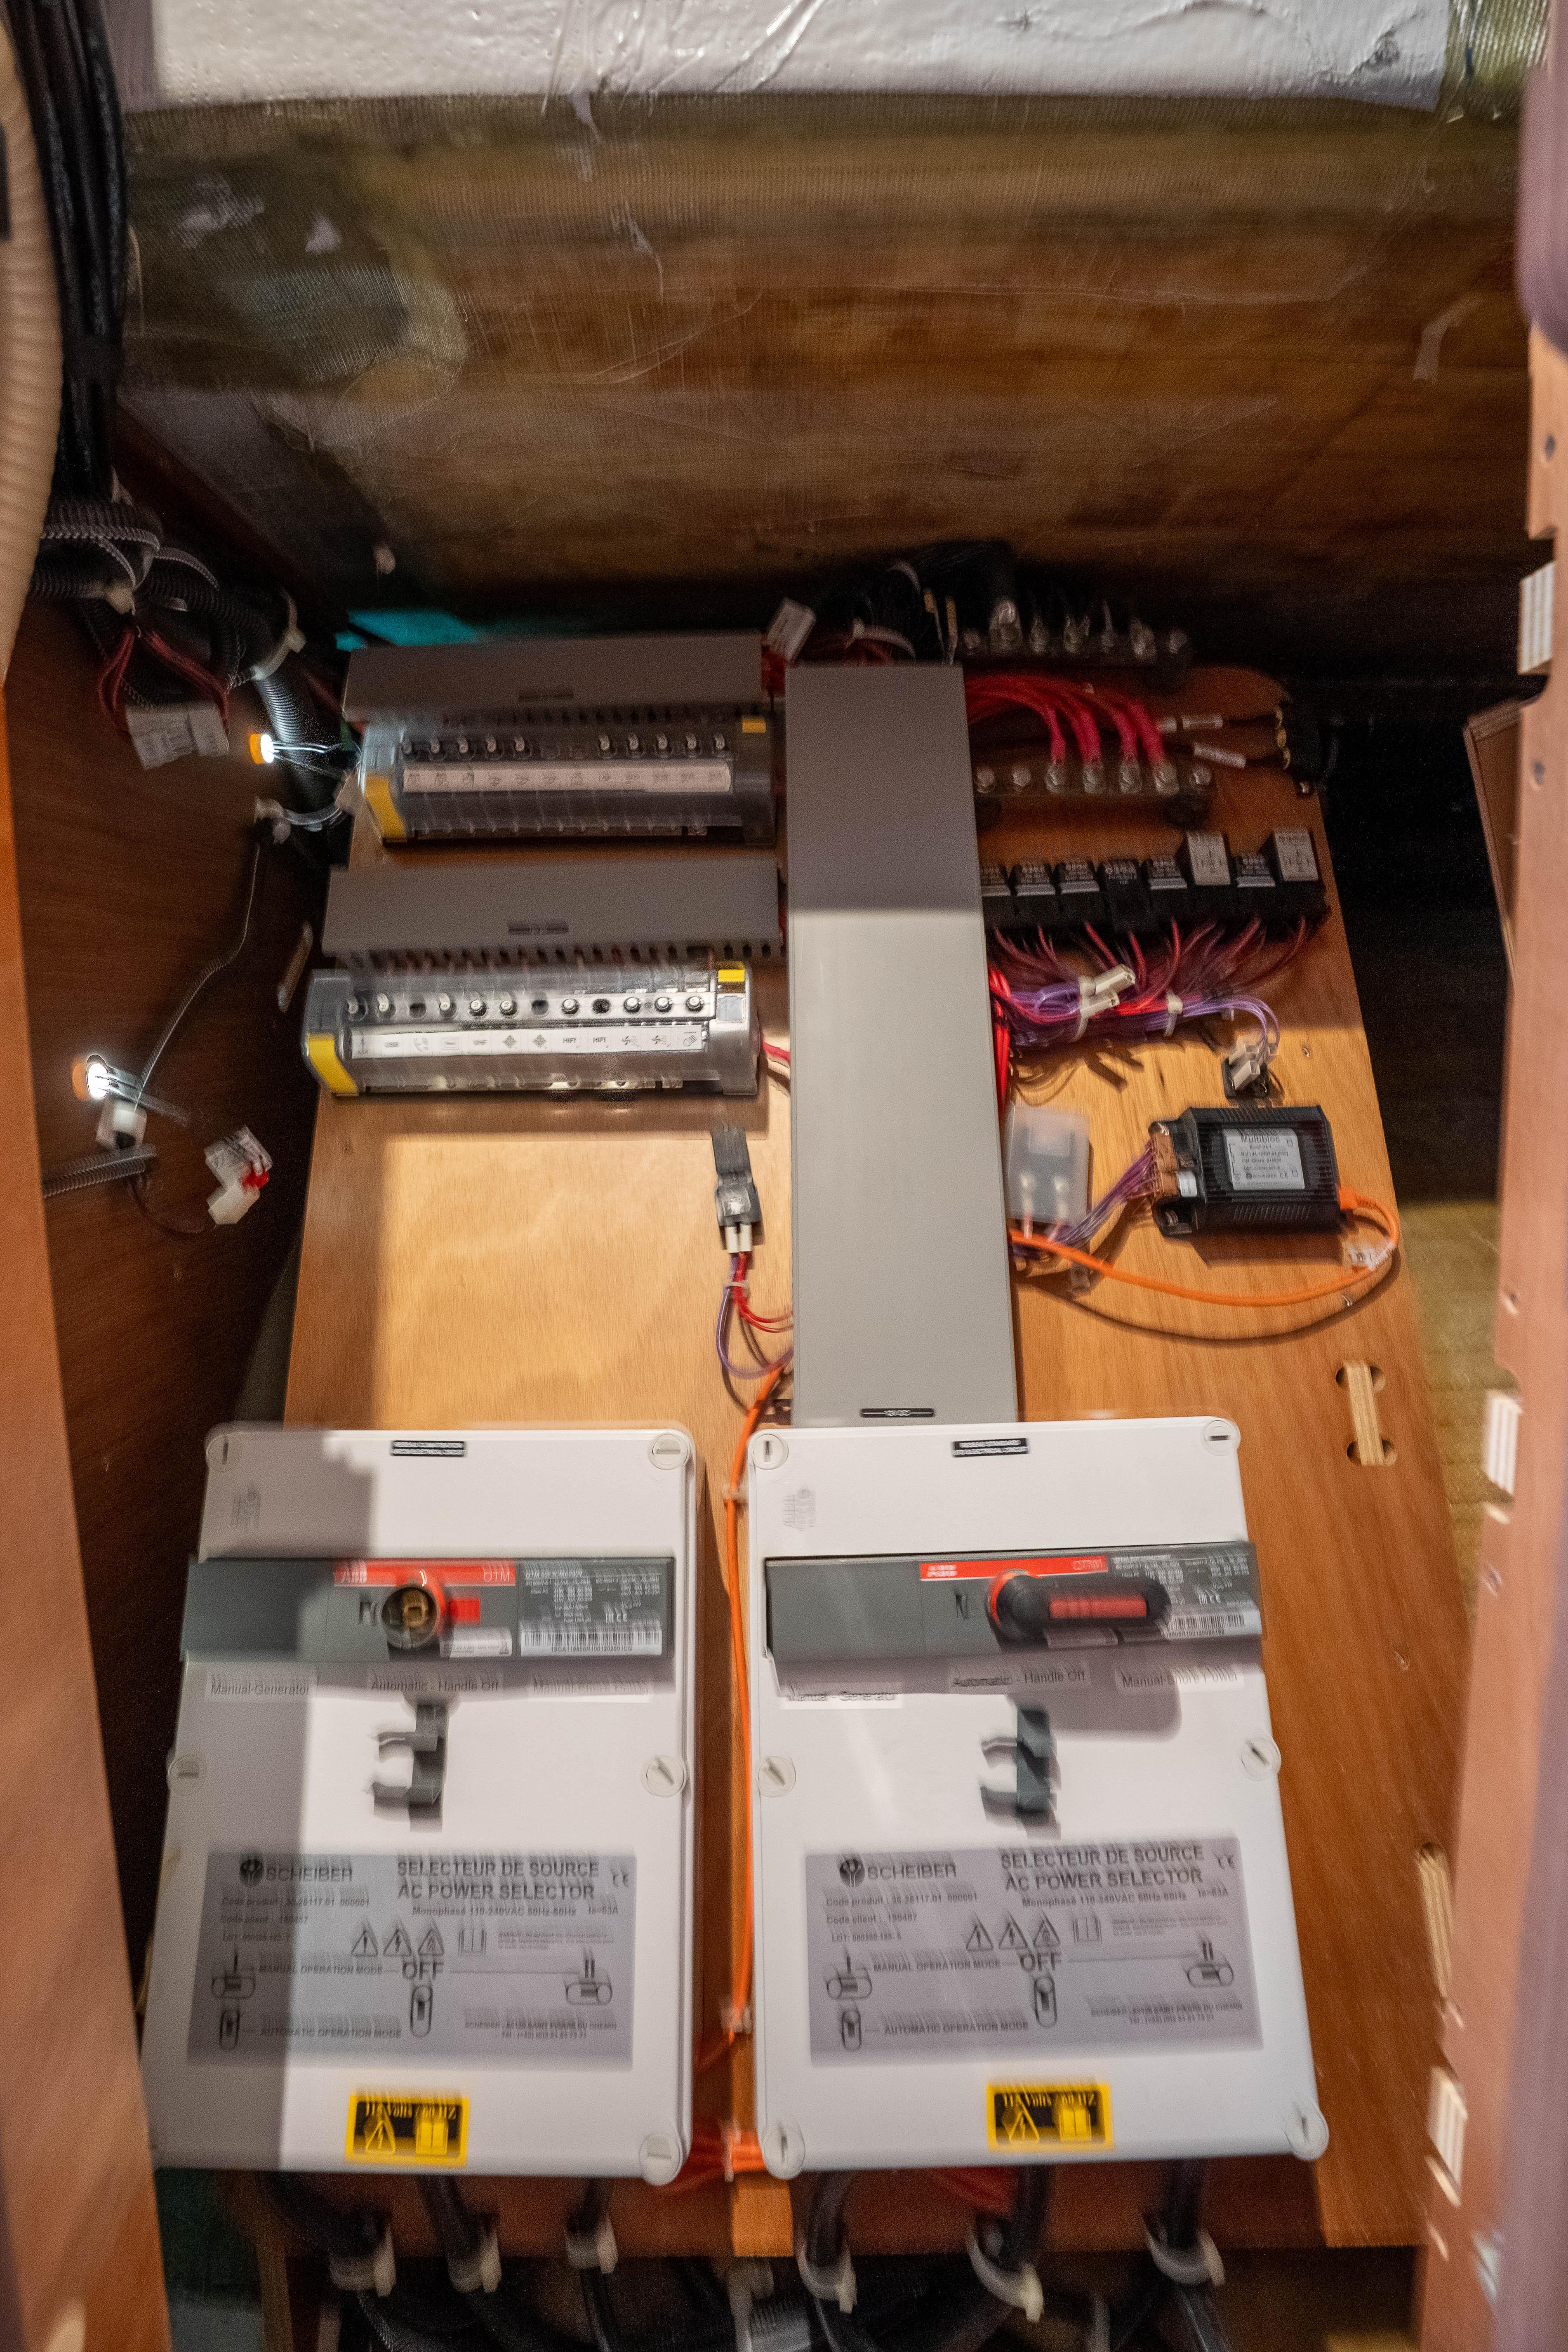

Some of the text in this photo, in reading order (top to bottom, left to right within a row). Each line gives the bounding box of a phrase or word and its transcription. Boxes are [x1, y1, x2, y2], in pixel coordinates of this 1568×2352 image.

[483, 1571, 510, 1582] OTM
[1025, 1673, 1064, 1684] Handle
[438, 1681, 478, 1692] Handle
[1001, 1846, 1204, 1870] SELECTEUR DE SOURCE
[266, 1867, 353, 1882] SCHEIBER
[398, 1862, 600, 1877] SELECTEUR DE SOURCE
[867, 1865, 957, 1881] SCHEIBER
[1005, 1868, 1203, 1892] AC POWER SELECTOR
[398, 1884, 595, 1900] AC POWER SELECTOR
[873, 1962, 914, 1973] MANUAL
[916, 1960, 971, 1971] OPERATION
[973, 1959, 1001, 1969] MODE
[1019, 1951, 1063, 1973] OFF
[300, 1964, 354, 1975] OPERATION
[356, 1965, 383, 1975] MODE
[401, 1960, 444, 1980] OFF
[260, 2027, 402, 2039] AUTOMATIC OPERATION MODE
[884, 2020, 1029, 2035] AUTOMATIC OPERATION MODE
